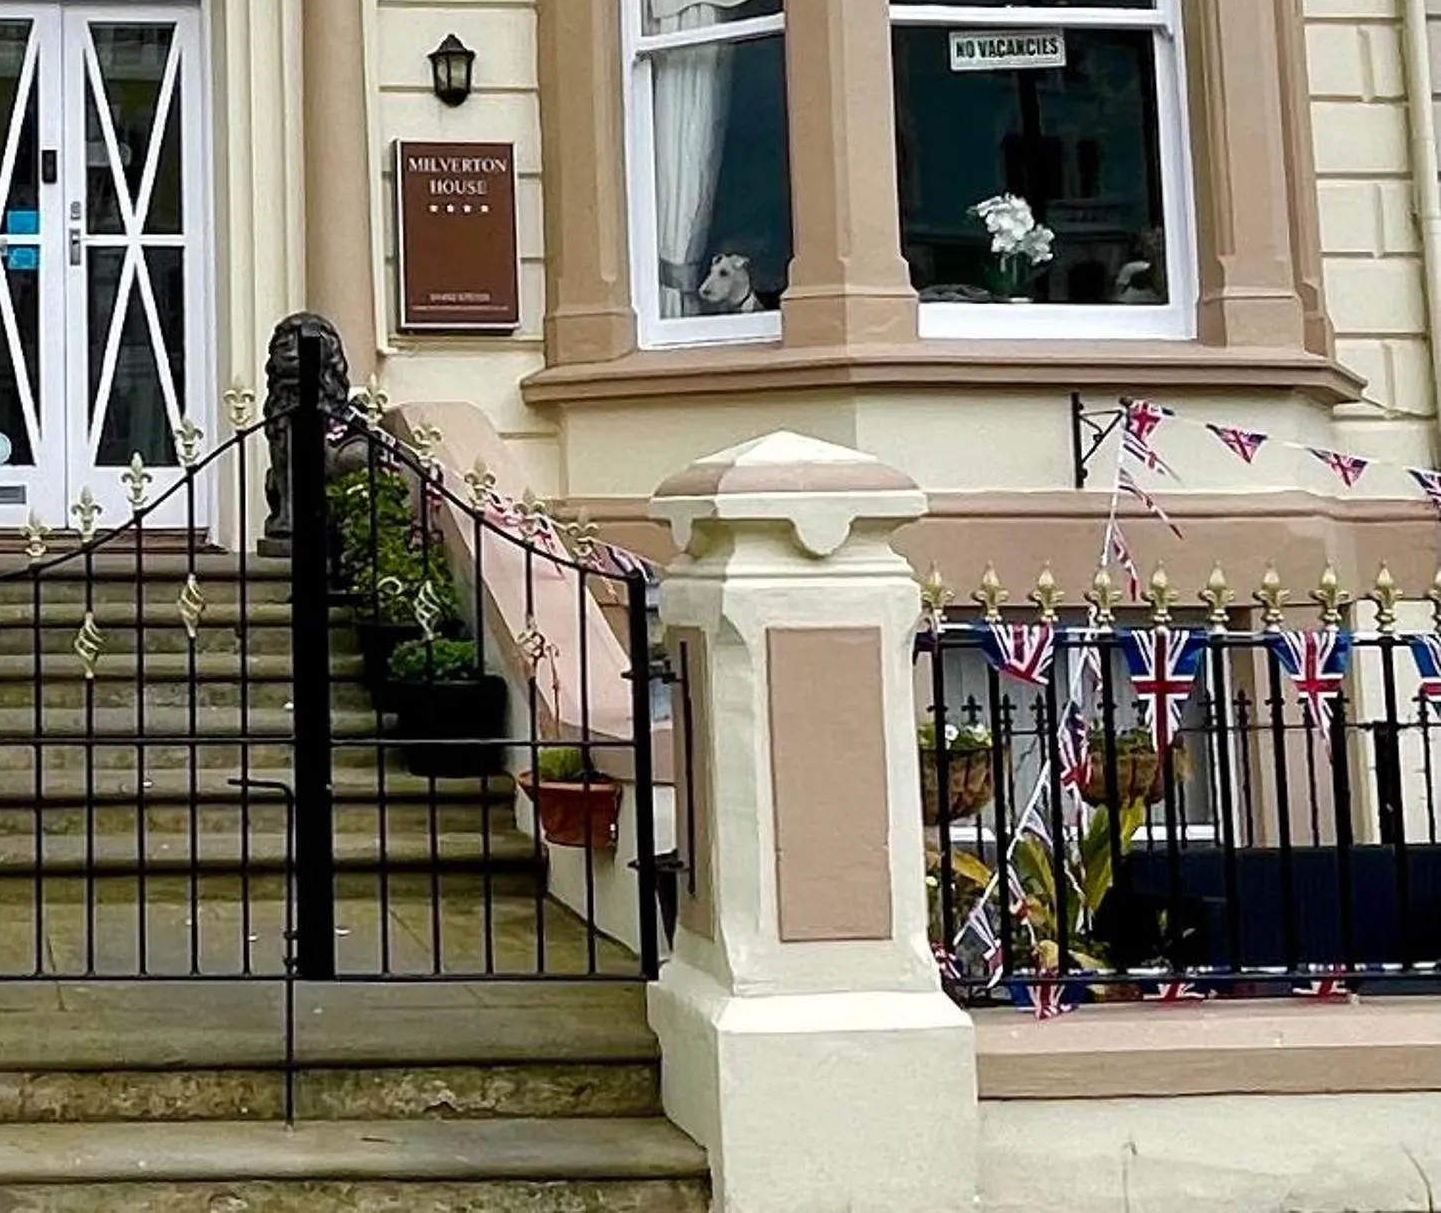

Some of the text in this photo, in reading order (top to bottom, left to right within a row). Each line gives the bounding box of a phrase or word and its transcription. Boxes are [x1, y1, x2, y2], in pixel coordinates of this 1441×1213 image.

[956, 37, 1058, 58] NO VACANCIES
[408, 157, 508, 173] MILVERTON
[429, 179, 487, 195] HOUSE
